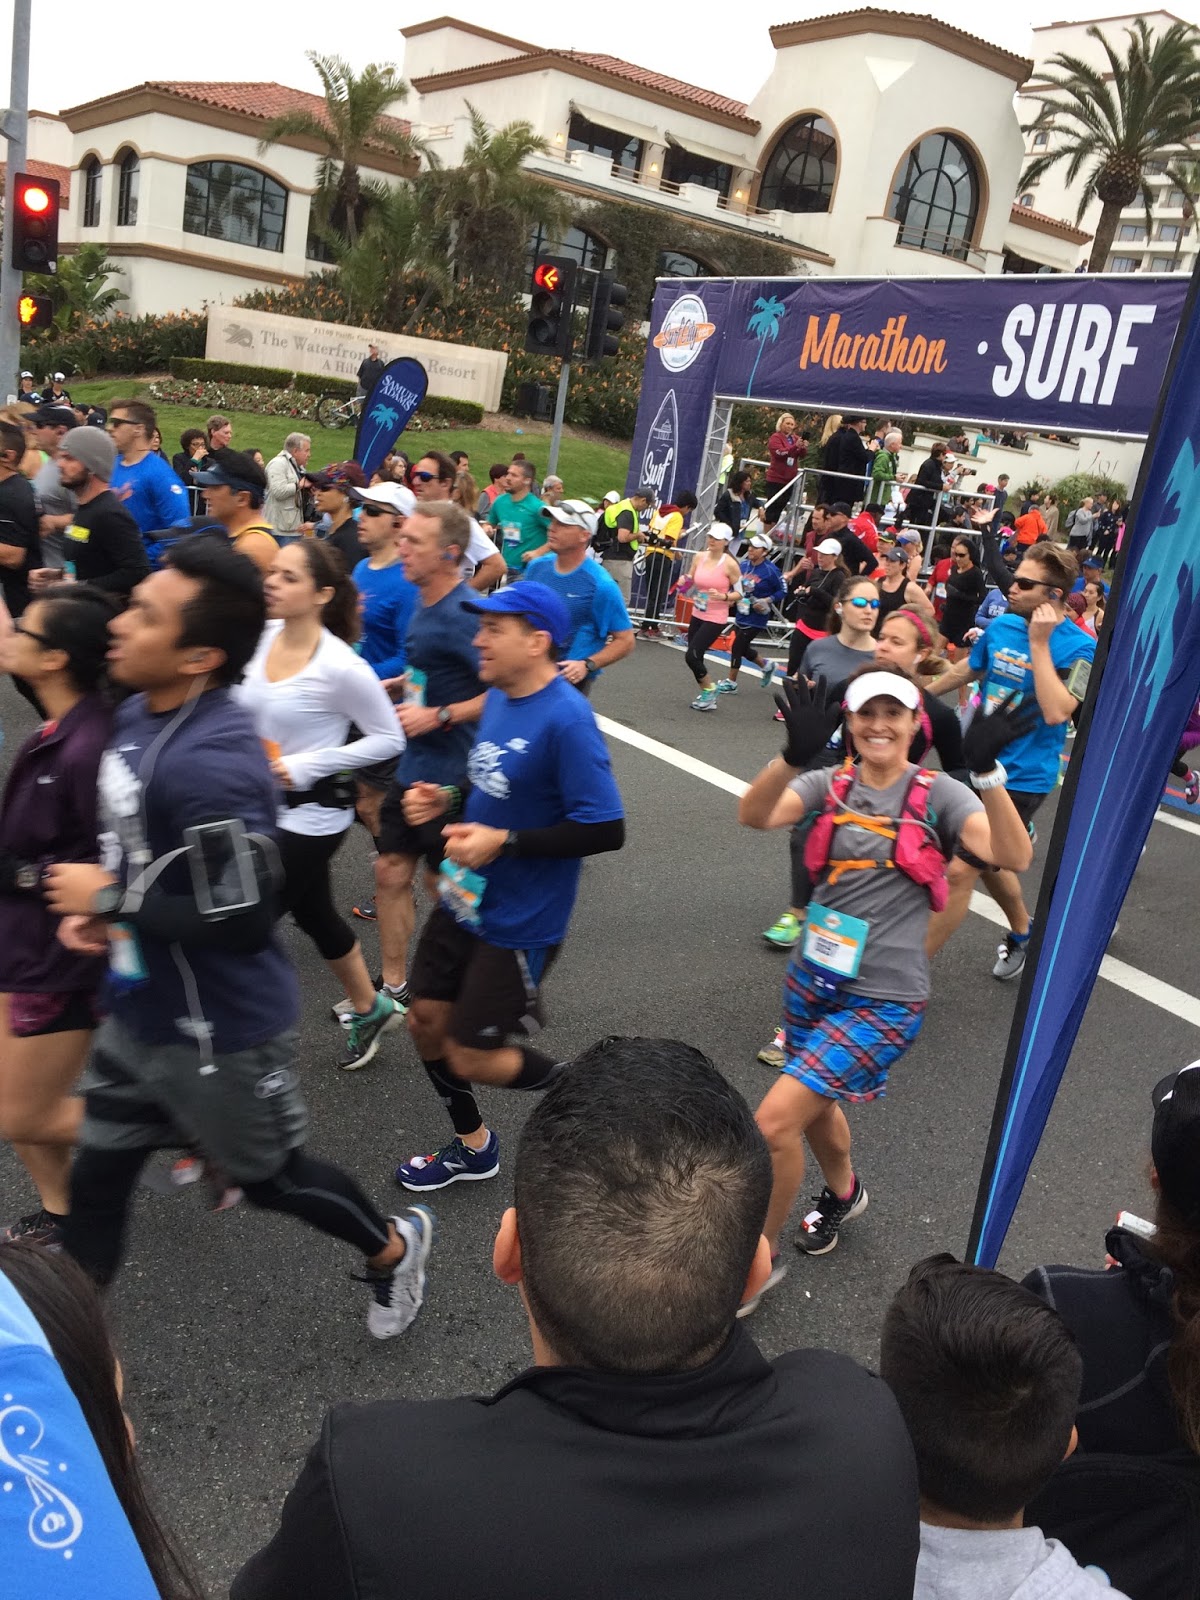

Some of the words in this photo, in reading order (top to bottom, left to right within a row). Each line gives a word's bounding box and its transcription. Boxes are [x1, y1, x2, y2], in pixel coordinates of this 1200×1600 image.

[260, 330, 288, 349] The
[293, 335, 370, 361] Waterfron
[427, 359, 476, 380] Resort
[322, 359, 331, 371] A
[799, 313, 948, 374] Marathon
[991, 303, 1157, 405] SURF
[379, 385, 411, 412] ADAMS
[382, 375, 419, 406] SAMUEL
[642, 447, 673, 491] Surf
